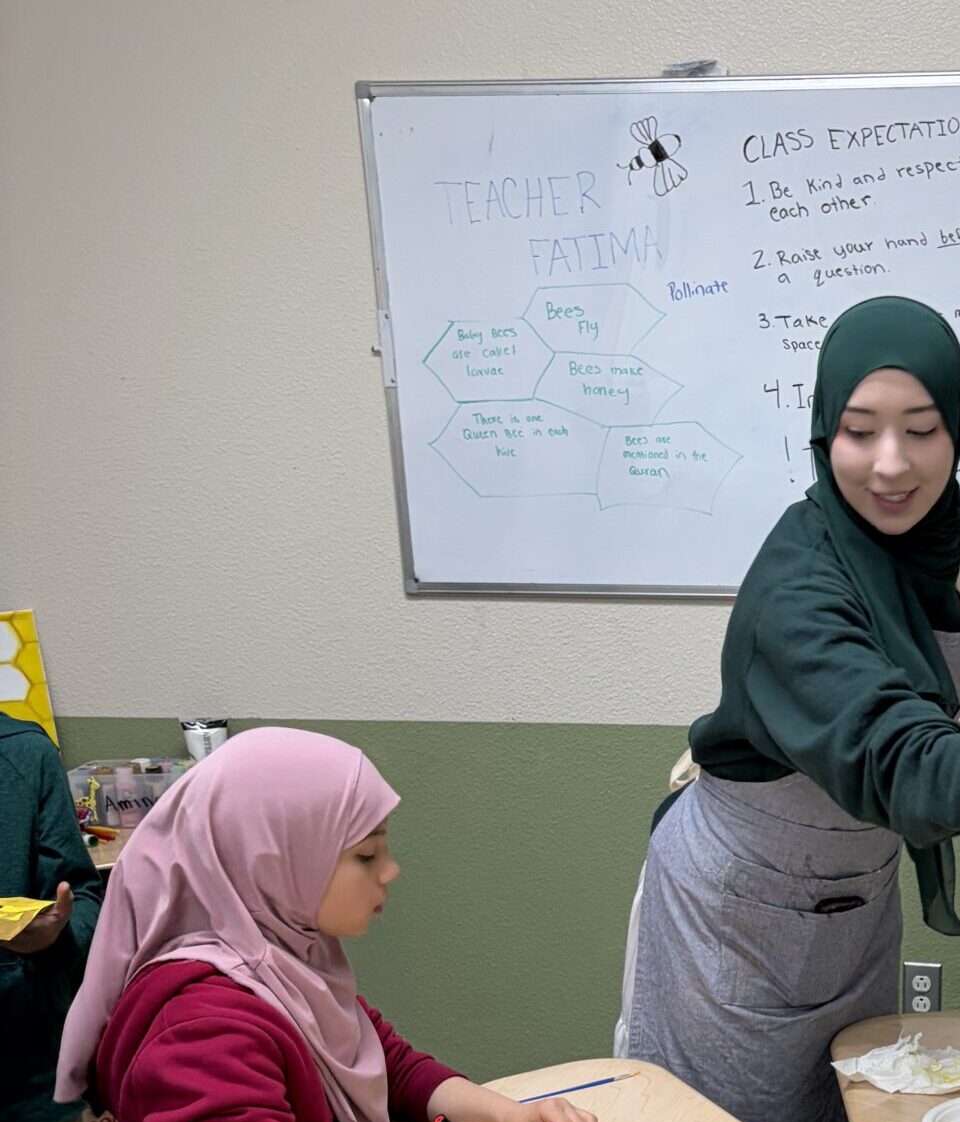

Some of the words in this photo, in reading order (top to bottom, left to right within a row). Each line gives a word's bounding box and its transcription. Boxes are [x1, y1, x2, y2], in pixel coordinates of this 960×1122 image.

[743, 128, 814, 164] CLASS
[742, 180, 765, 206] 1.
[769, 180, 794, 200] Be
[853, 167, 886, 185] and
[434, 171, 602, 226] TEACHER
[769, 201, 809, 222] each
[529, 225, 664, 276] FATIMA
[752, 249, 772, 270] 2.
[776, 247, 822, 266] Raise
[833, 241, 873, 260] your
[884, 231, 928, 249] hand
[777, 272, 791, 284] a
[667, 280, 729, 302] Pollinate
[546, 302, 585, 320] Bees
[457, 329, 483, 345] Baby
[578, 320, 599, 341] Fly
[452, 349, 471, 359] are
[466, 364, 504, 377] larvae
[569, 361, 601, 376] Bees
[582, 383, 630, 406] honey
[625, 435, 648, 446] Bees
[623, 448, 668, 460] mentioned
[629, 465, 670, 478] Quran
